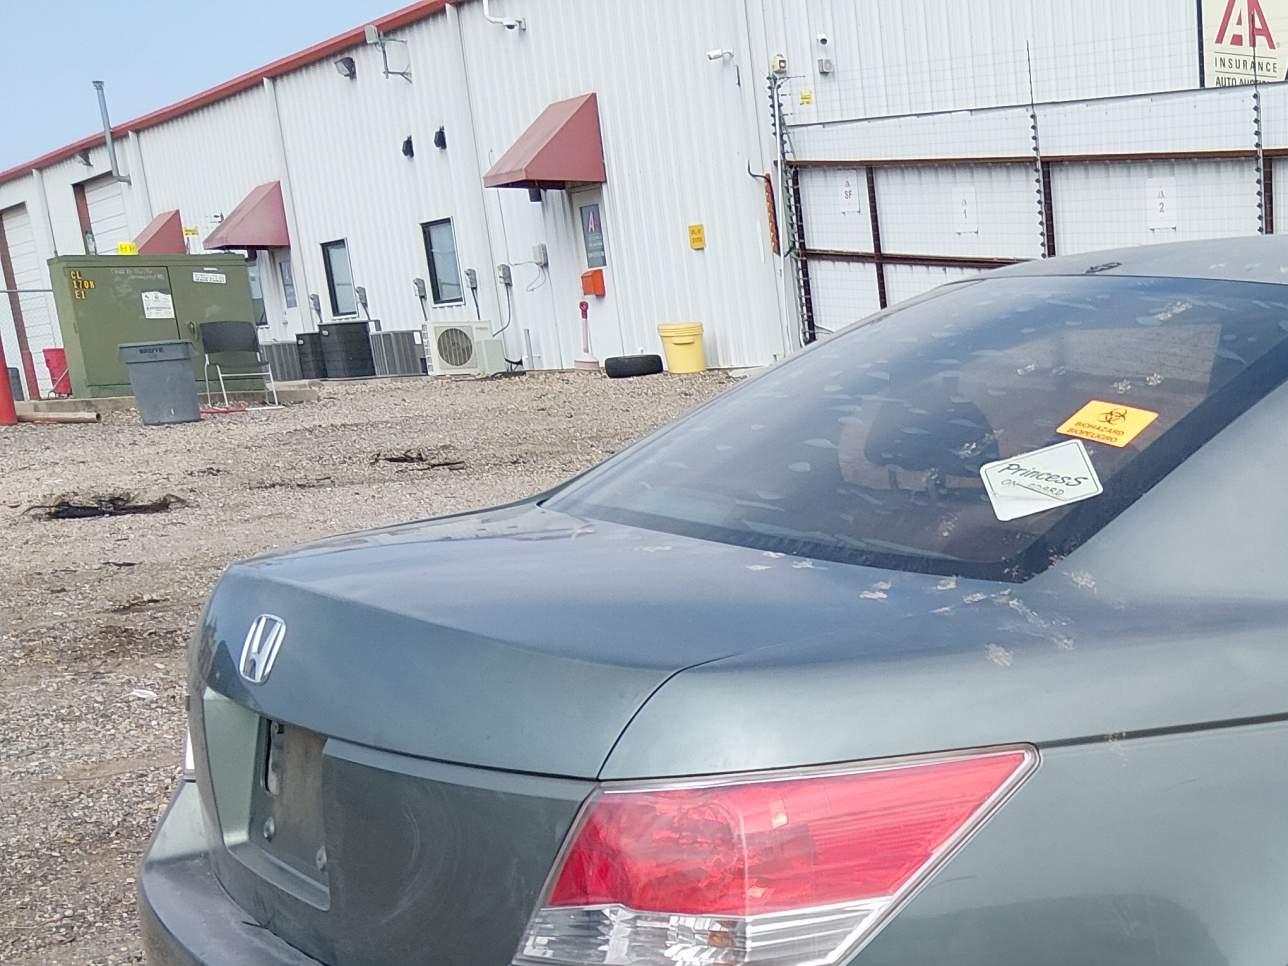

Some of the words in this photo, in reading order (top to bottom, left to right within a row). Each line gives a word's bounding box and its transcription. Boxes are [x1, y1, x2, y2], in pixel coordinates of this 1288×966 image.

[1215, 56, 1278, 72] INSURANCE
[1159, 202, 1165, 213] 2
[1074, 421, 1125, 436] BIOHAZARD
